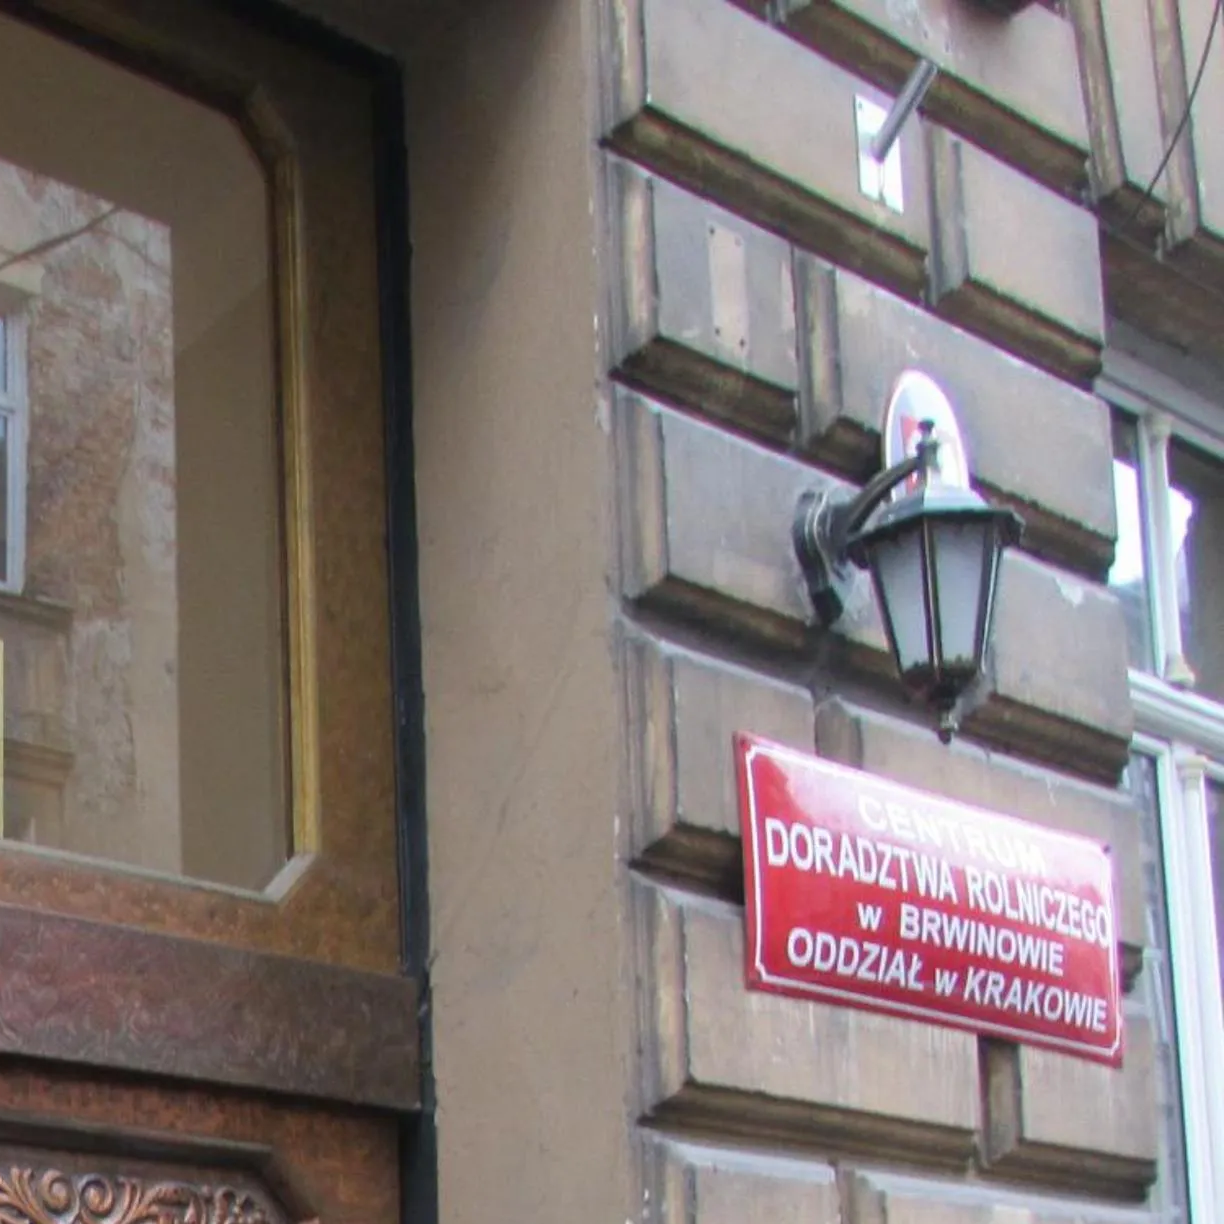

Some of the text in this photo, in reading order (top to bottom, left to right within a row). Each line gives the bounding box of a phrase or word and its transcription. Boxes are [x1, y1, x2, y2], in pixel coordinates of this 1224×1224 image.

[764, 817, 1111, 947] DORADZTWA ROLNICZEGO
[857, 793, 1048, 877] CENTRUM
[786, 926, 925, 992] ODDZIAŁ
[962, 965, 1108, 1033] KRAKOWIE
[899, 902, 1064, 976] BRWINOWIE
